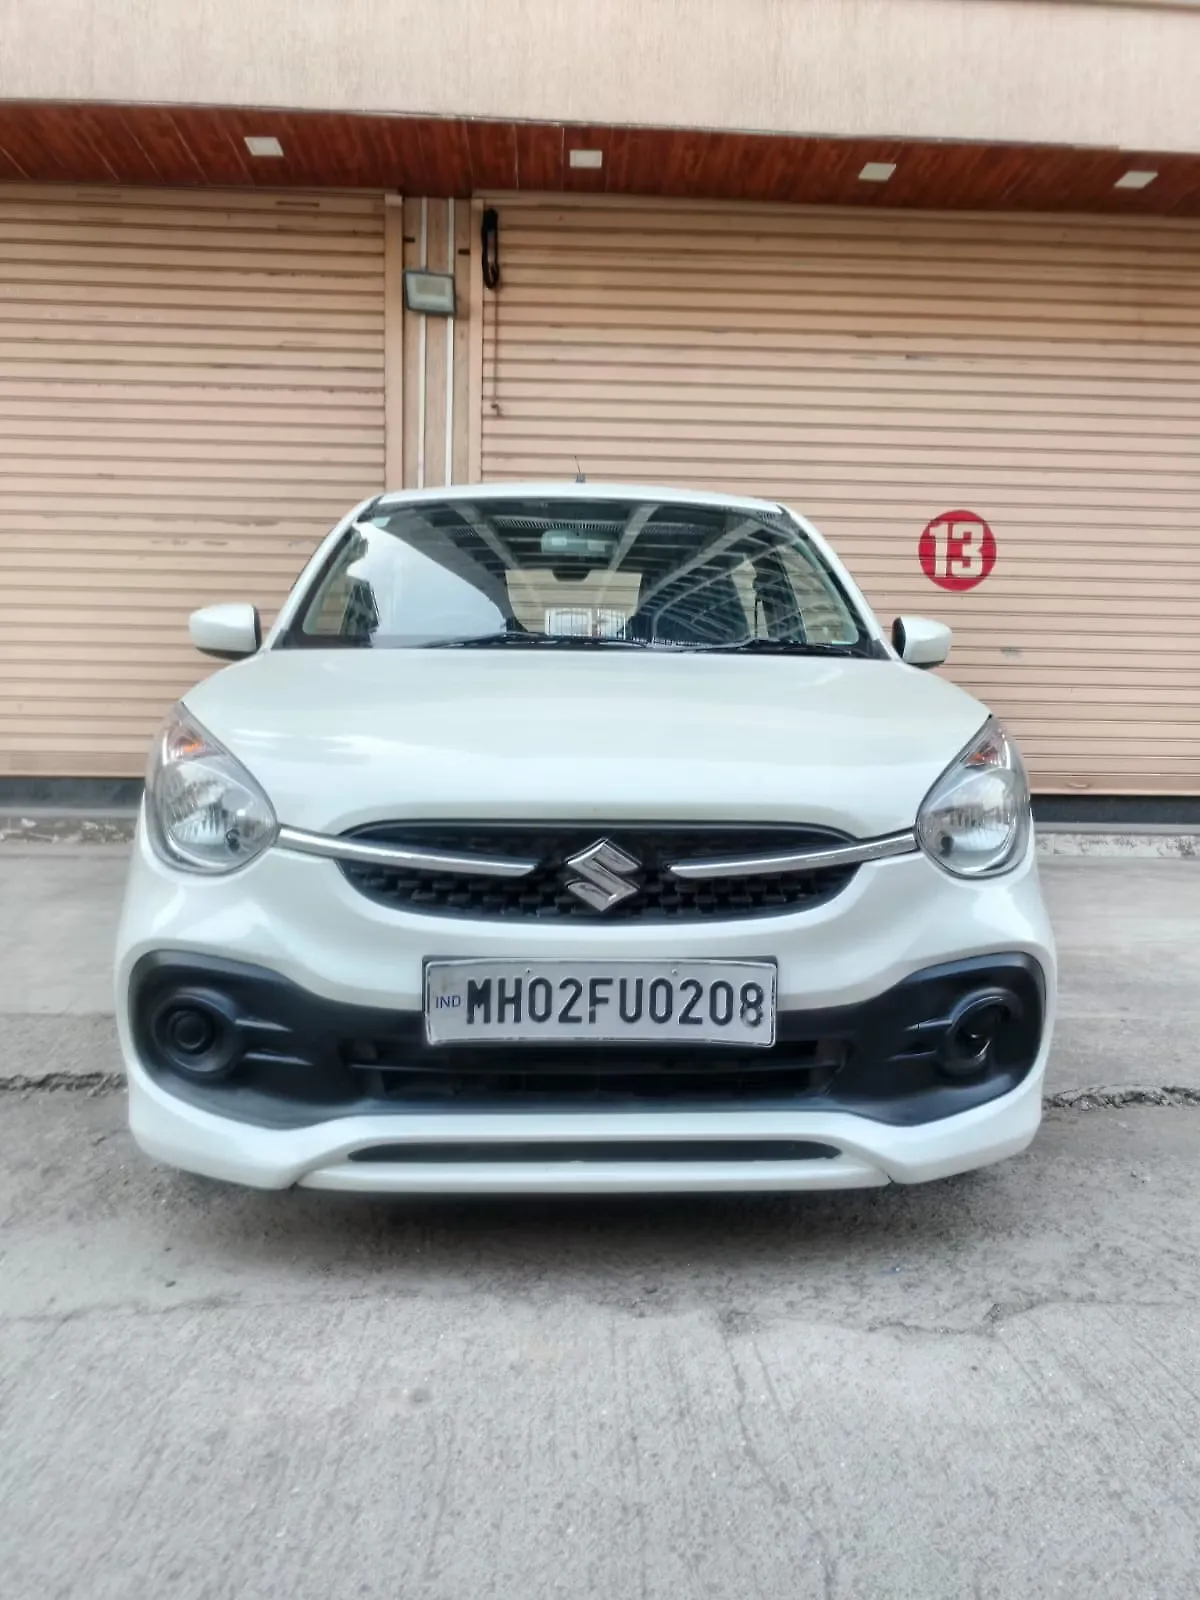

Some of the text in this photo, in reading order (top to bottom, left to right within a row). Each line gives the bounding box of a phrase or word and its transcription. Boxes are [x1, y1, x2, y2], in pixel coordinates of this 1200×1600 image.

[929, 522, 984, 577] 13
[435, 978, 764, 1028] IND MH02FU0208
